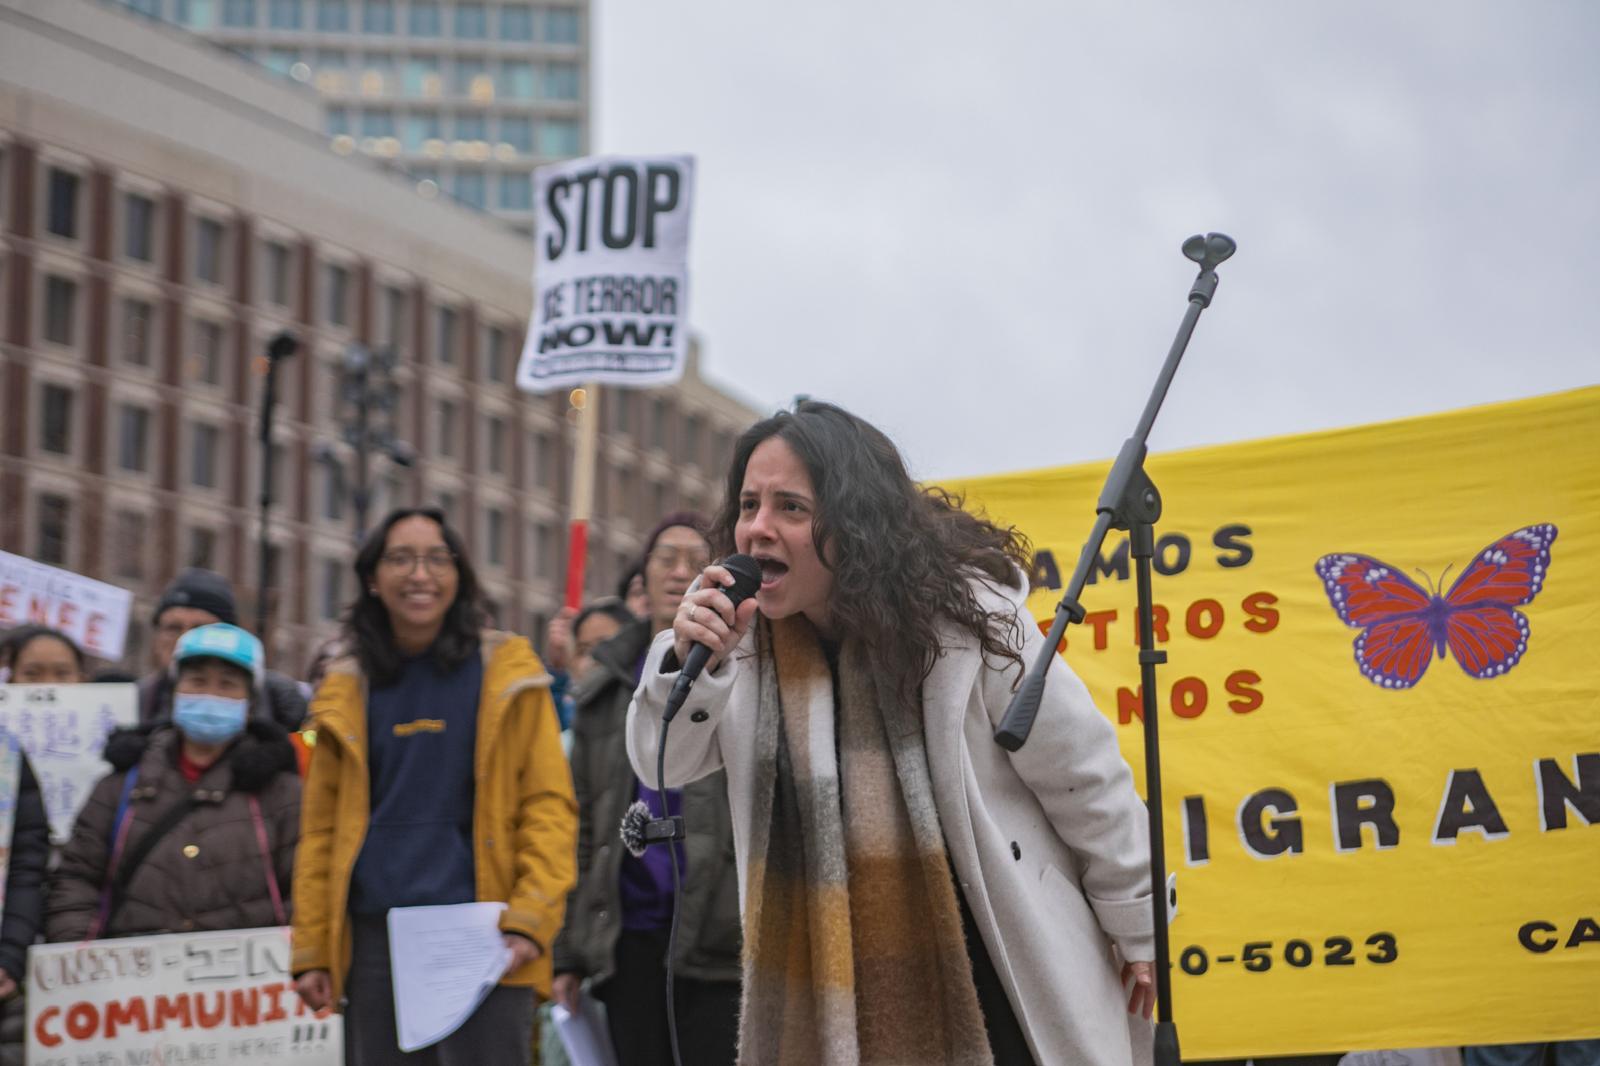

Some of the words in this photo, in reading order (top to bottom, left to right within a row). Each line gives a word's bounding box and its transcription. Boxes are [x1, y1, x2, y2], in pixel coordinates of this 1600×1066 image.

[546, 163, 680, 261] STOP
[574, 274, 678, 316] TERROR
[538, 320, 675, 354] NOW!
[1117, 669, 1264, 725] NOS
[1181, 752, 1600, 866] IGRAN
[35, 981, 332, 1048] COMMUNI
